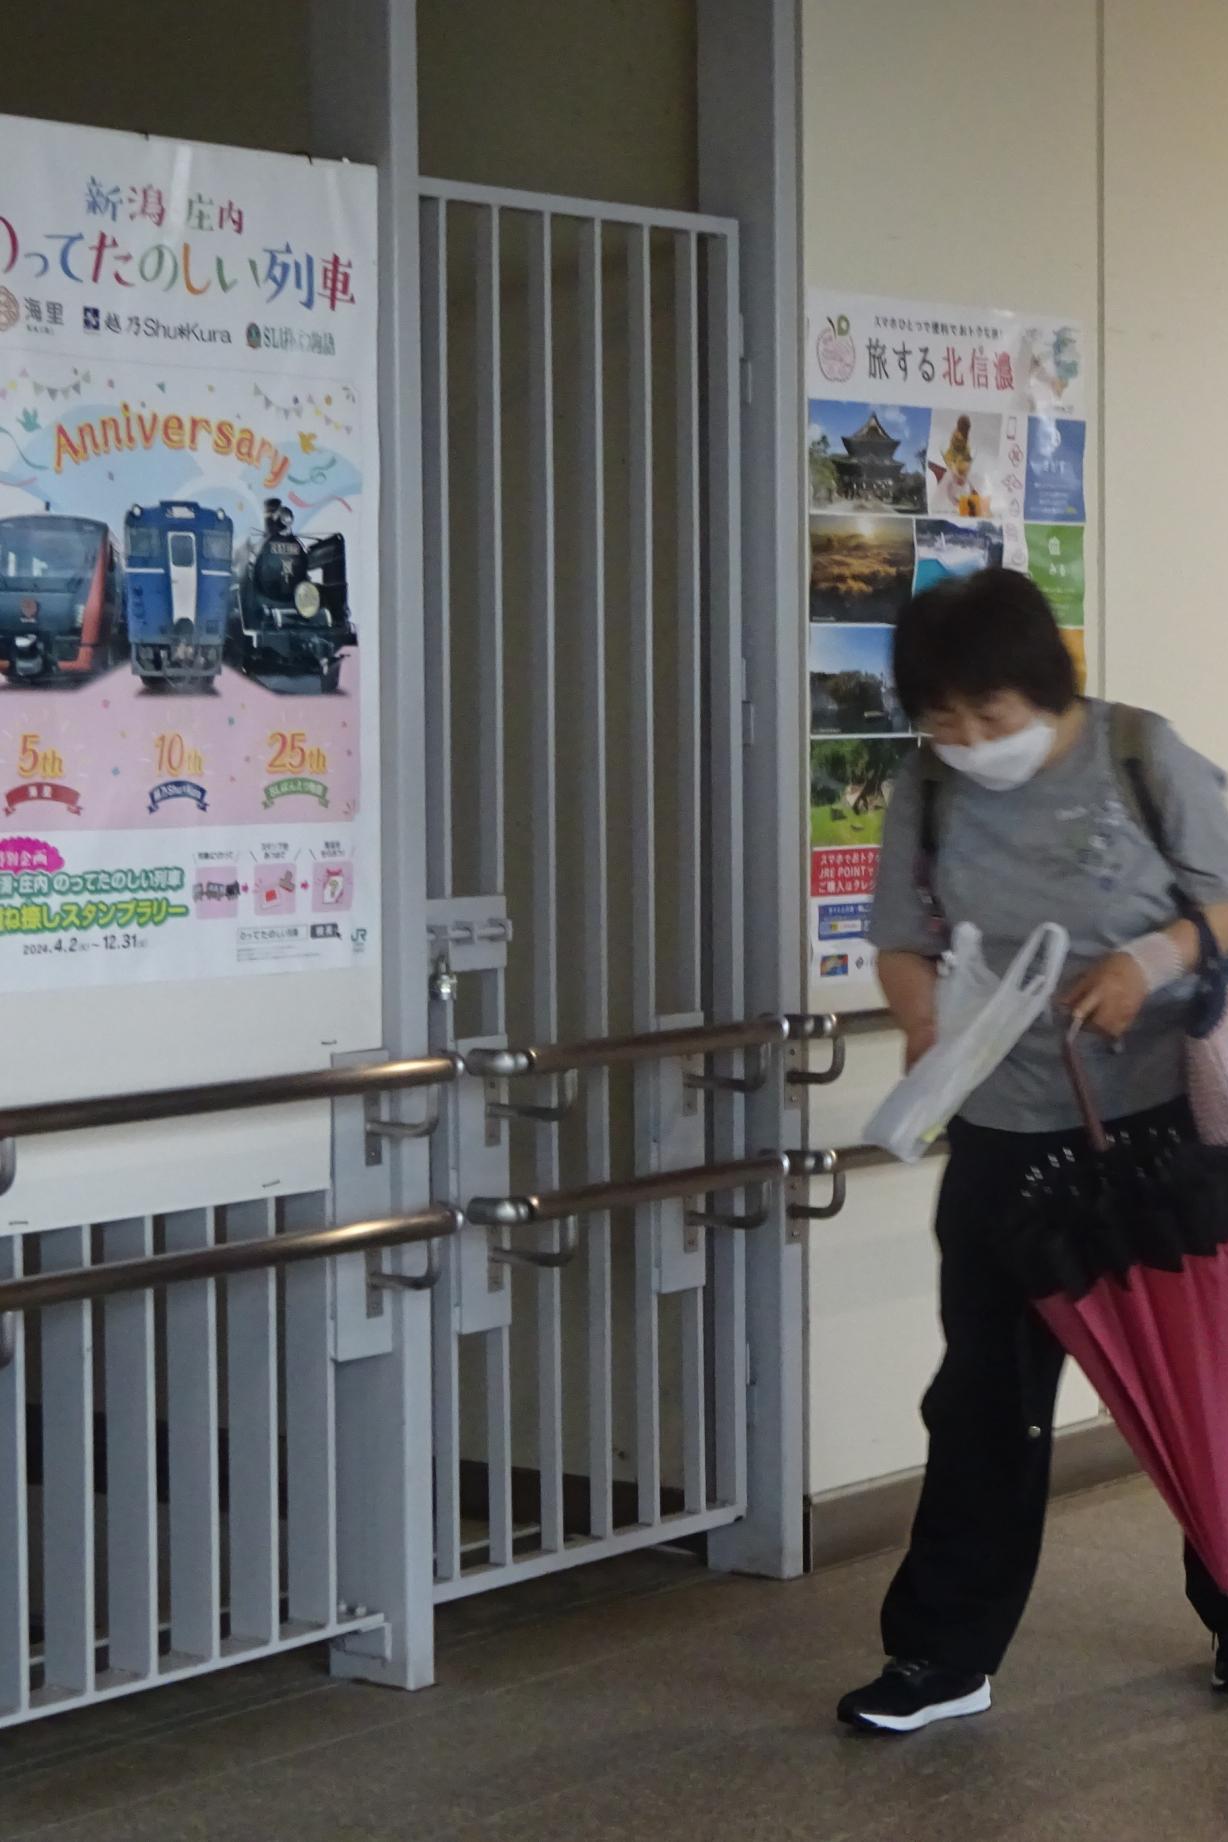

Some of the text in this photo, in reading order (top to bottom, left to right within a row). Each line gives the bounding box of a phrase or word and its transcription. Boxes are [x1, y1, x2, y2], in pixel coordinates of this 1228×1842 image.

[866, 337, 1015, 391] 旅する北信濃
[54, 402, 290, 489] Anniversary
[17, 732, 64, 779] 5th
[154, 732, 205, 777] 10th
[266, 731, 328, 775] 25th
